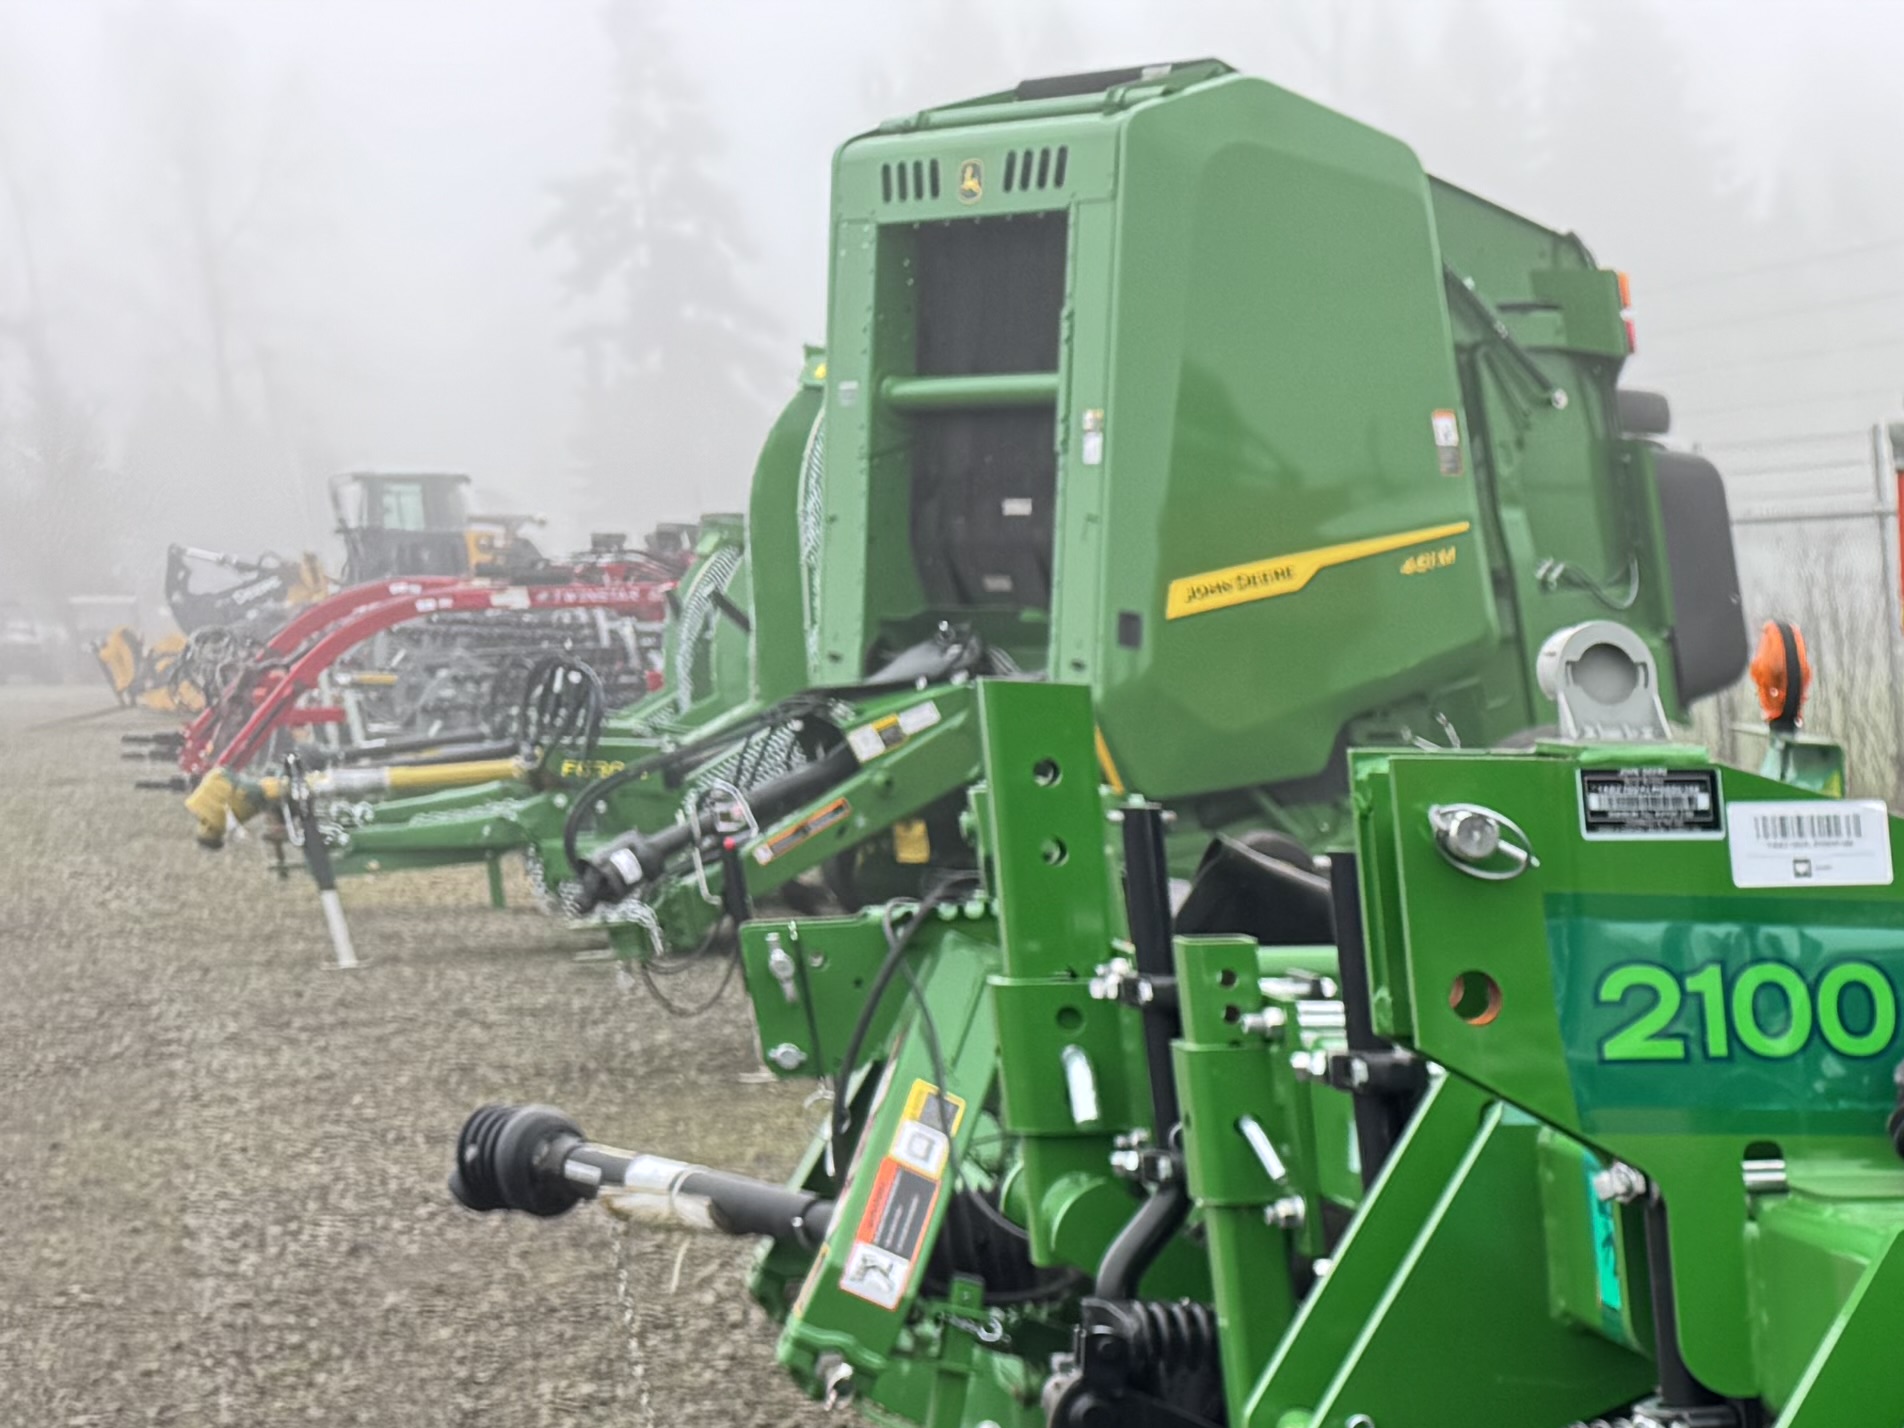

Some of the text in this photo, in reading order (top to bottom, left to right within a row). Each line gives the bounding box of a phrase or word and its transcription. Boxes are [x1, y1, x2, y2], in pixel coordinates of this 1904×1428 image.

[1184, 565, 1296, 604] JOHN DEERE
[1599, 962, 1896, 1060] 2100
